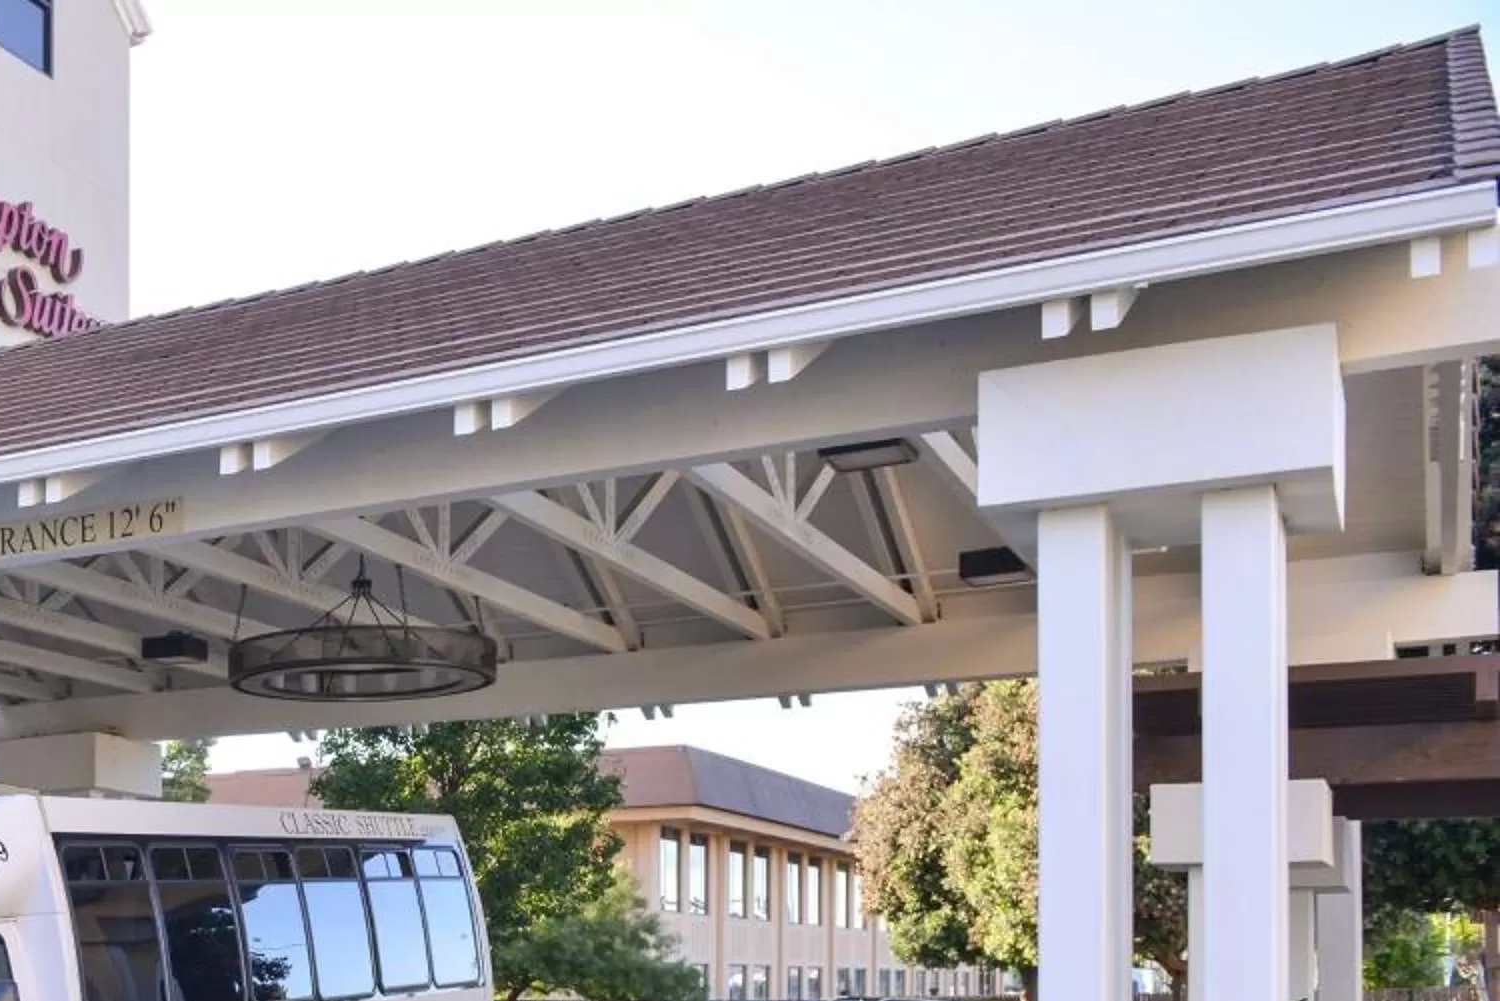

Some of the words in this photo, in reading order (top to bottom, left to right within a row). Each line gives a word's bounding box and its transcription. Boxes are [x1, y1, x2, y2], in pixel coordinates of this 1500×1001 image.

[108, 504, 141, 540] 12'
[148, 499, 177, 534] 6"
[279, 811, 352, 836] CLASSIC
[355, 815, 419, 837] SHUTTLE
